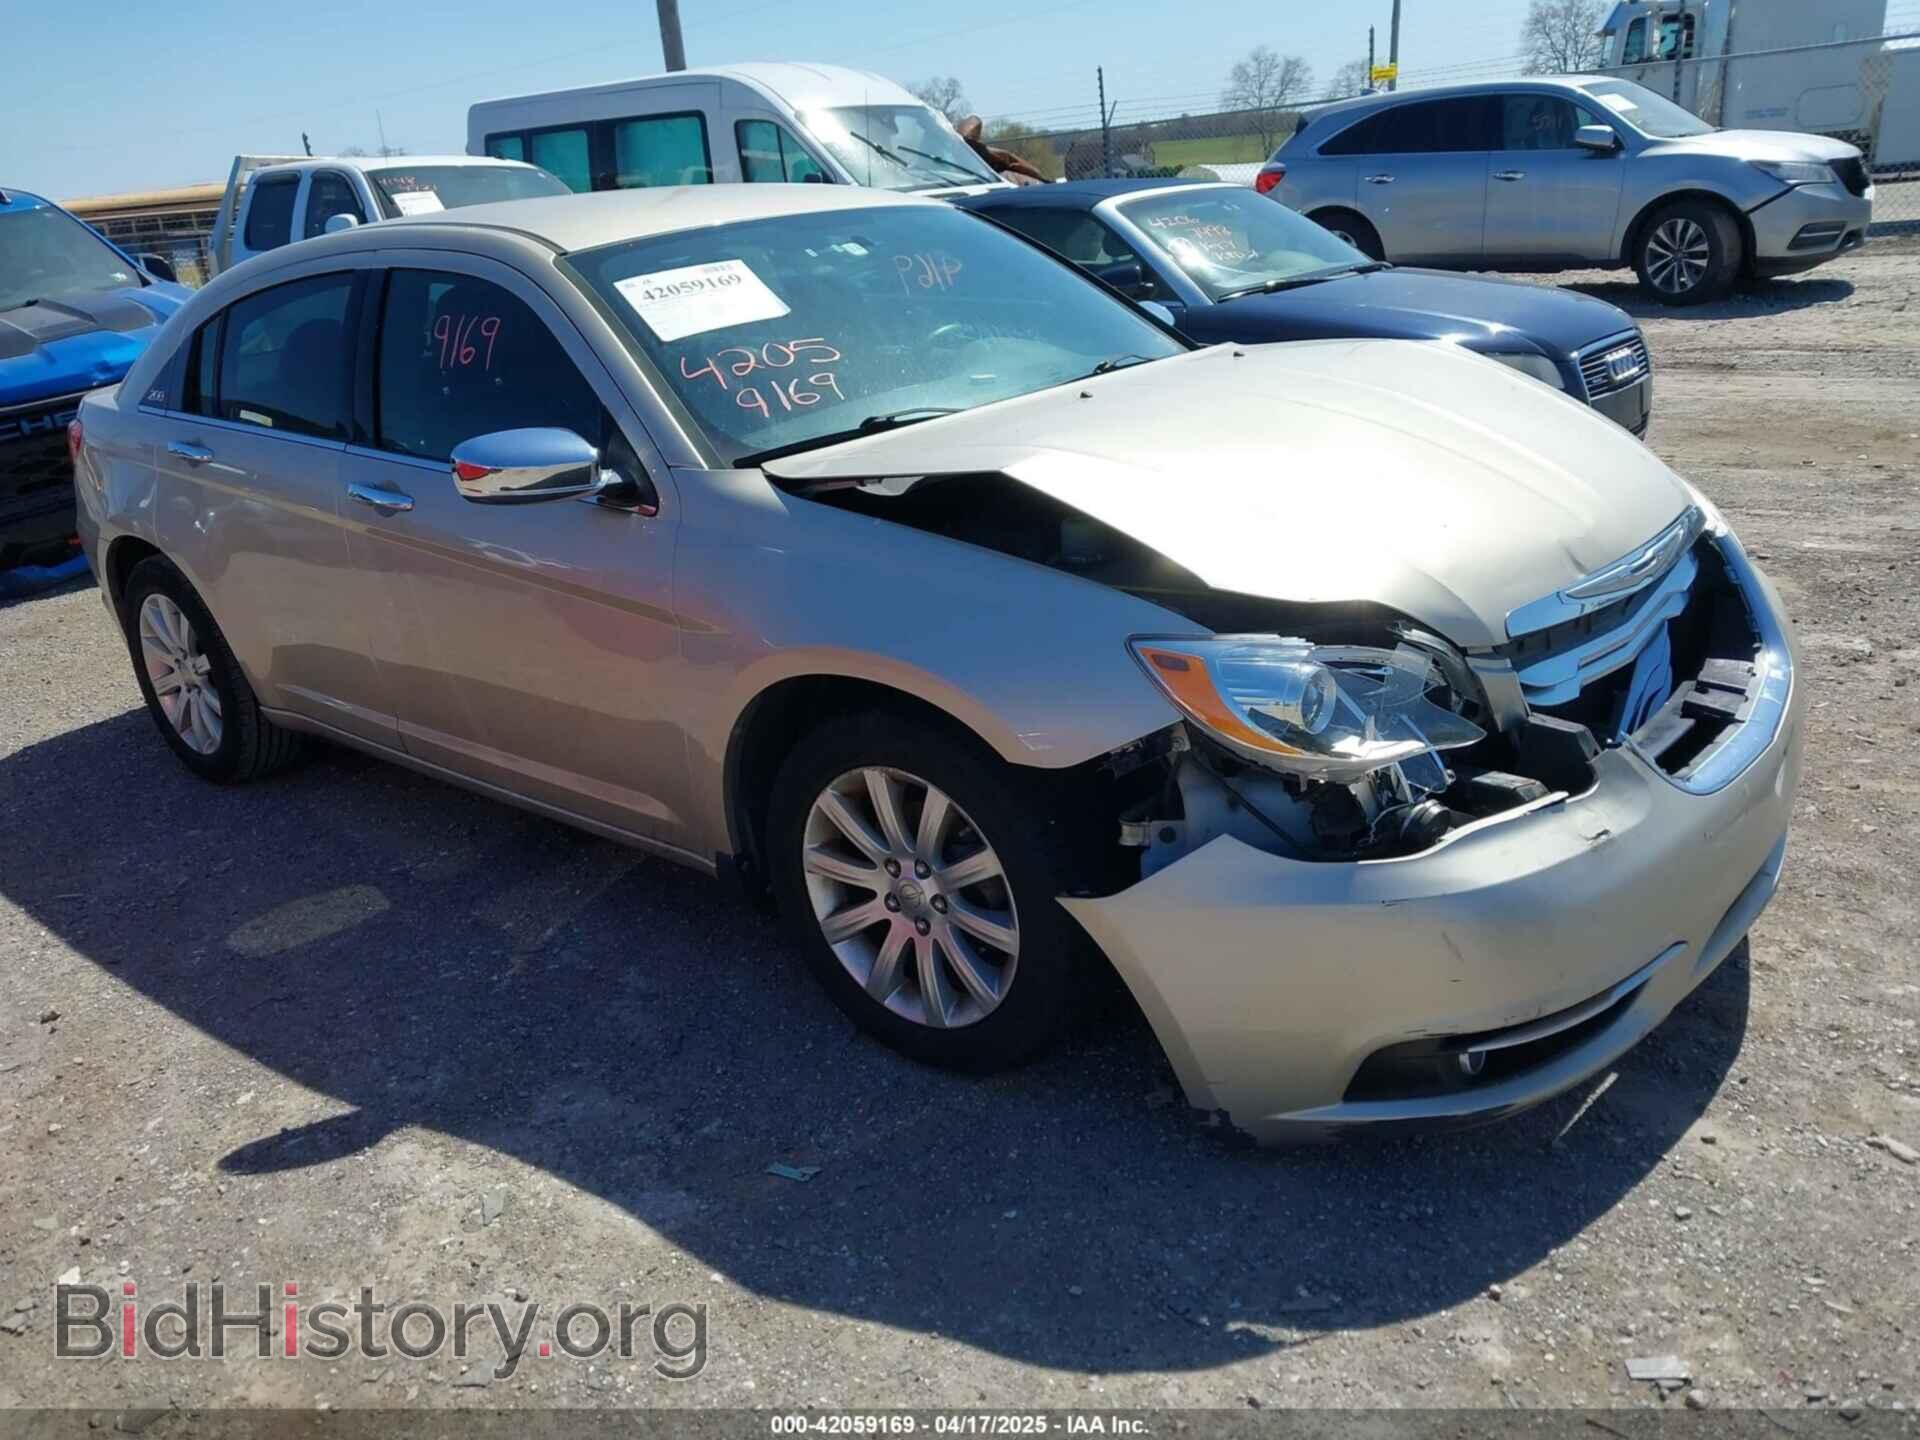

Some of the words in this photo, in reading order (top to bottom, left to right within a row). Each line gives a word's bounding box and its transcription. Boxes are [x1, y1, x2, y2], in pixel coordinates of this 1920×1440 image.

[642, 273, 742, 301] 42059169
[434, 314, 501, 372] 9169
[680, 337, 841, 390] 4205
[736, 372, 845, 418] 9169
